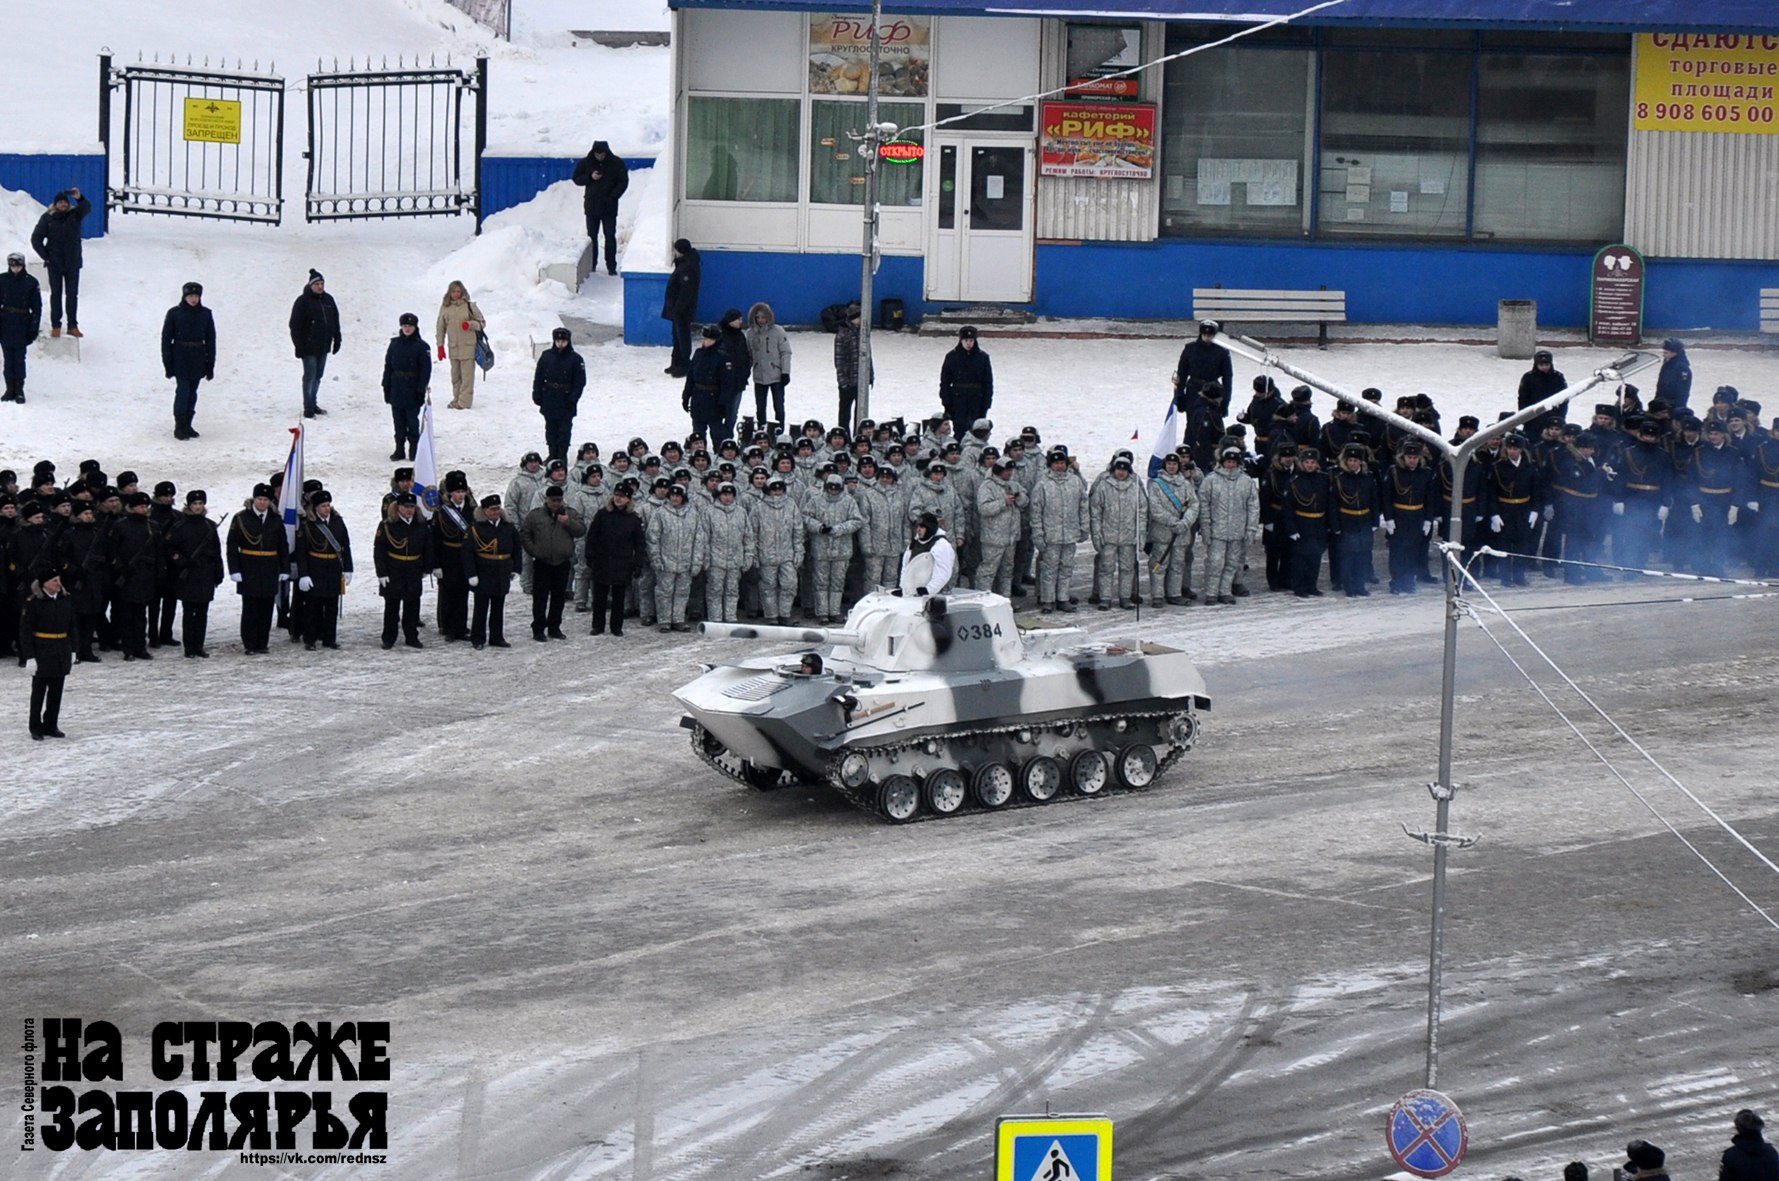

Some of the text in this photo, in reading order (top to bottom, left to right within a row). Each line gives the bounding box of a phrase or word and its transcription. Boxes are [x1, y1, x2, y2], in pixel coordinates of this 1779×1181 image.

[831, 20, 911, 45] РИФ
[831, 45, 910, 55] КРУГЛОСТОЧНО
[1670, 60, 1778, 78] торговые
[1671, 84, 1774, 100] площади
[1063, 111, 1136, 121] кафетерий
[1637, 102, 1773, 123] 8 908 605 00
[186, 129, 237, 140] ЗАПРЕЩЕН
[1047, 120, 1150, 139] «РИФ»
[880, 145, 926, 157] ОТКРЫТО
[971, 622, 1002, 640] 384
